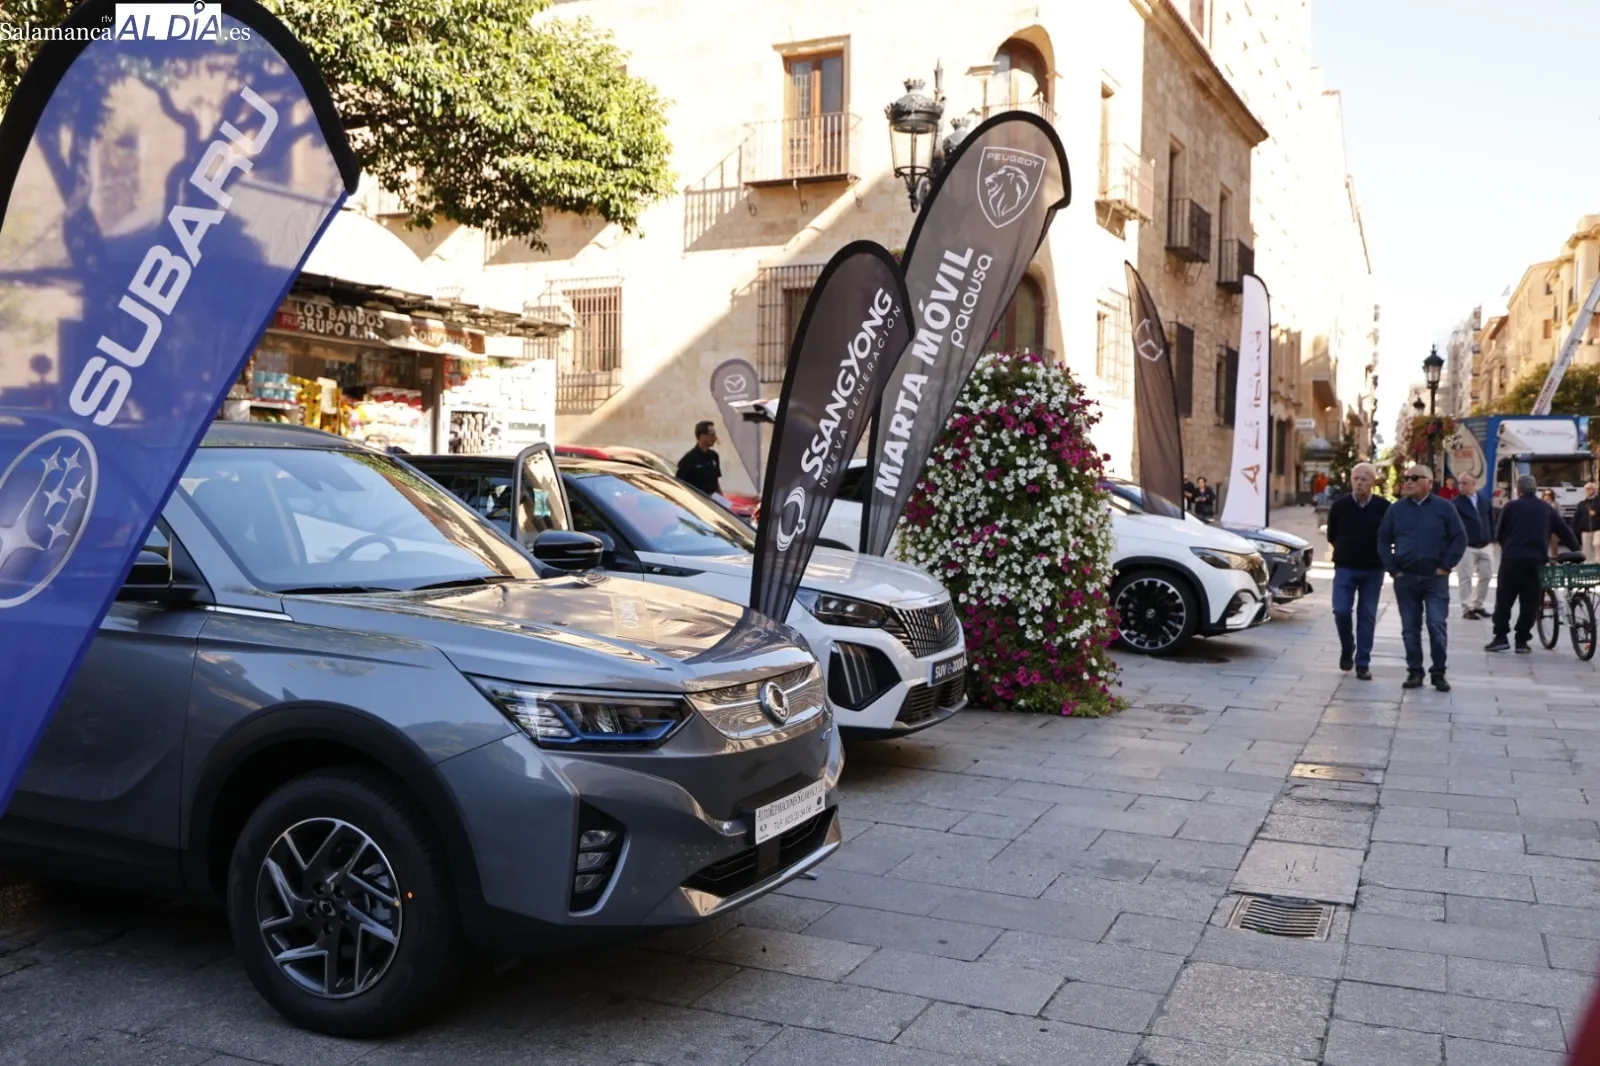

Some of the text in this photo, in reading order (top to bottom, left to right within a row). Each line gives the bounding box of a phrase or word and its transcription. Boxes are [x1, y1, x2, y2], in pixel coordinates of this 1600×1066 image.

[986, 152, 1040, 168] PEUGEOT
[69, 86, 279, 426] SUBARU
[296, 302, 385, 329] LOS BANDOS
[951, 254, 993, 349] palausa
[298, 317, 345, 336] GRUPO
[801, 287, 893, 481] SSANGYONG
[874, 246, 974, 498] MARTA MÓVIL
[819, 305, 901, 489] NUEVA GENERACIÓN
